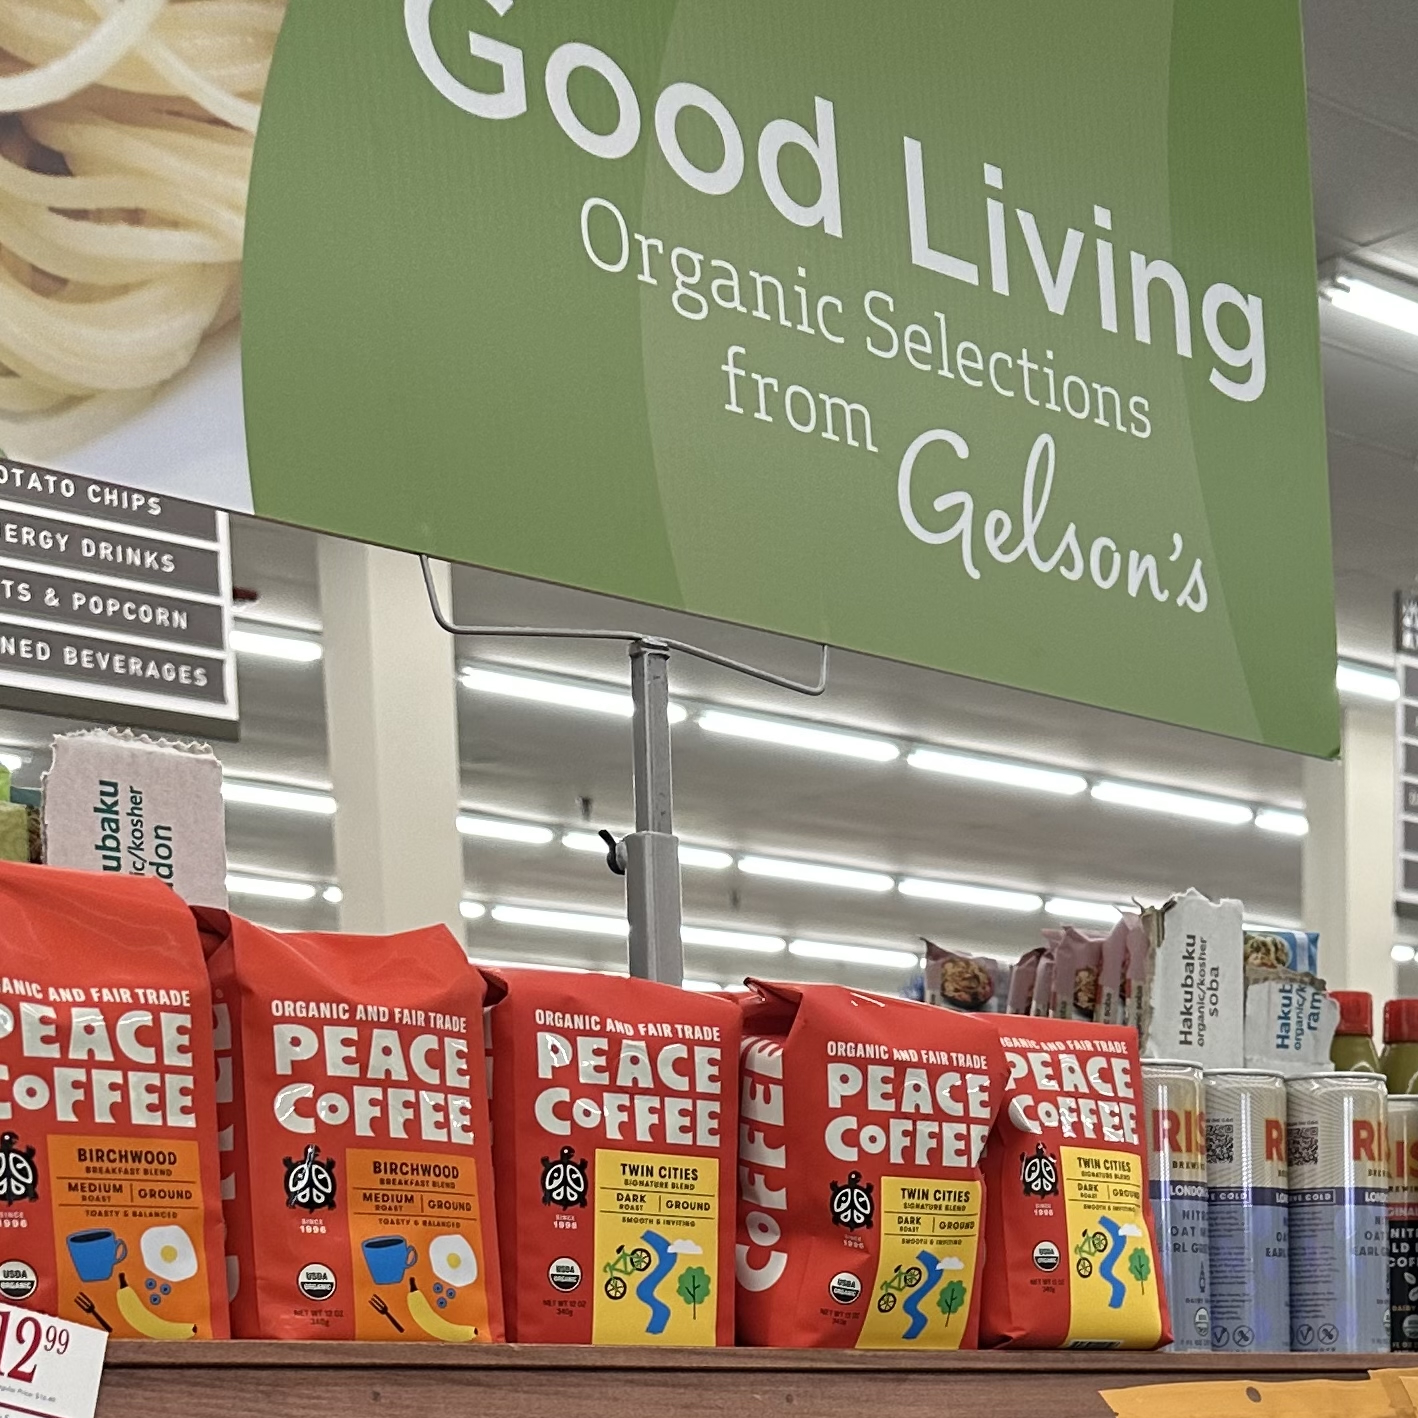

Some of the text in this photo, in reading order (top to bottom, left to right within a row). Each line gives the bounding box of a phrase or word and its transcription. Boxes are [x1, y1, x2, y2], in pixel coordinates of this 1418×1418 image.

[404, 0, 1266, 402] Good Living
[581, 198, 1151, 439] Organic Selections
[721, 345, 878, 452] from
[87, 484, 162, 516] CHIPS
[898, 429, 1208, 612] Gelson's
[82, 538, 175, 572] DRINKS
[44, 588, 60, 607] &
[72, 592, 187, 630] POPCORN
[63, 645, 208, 686] BEVERAGES
[0, 977, 190, 1007] ANIC AND FAIR TRADE
[1179, 934, 1196, 1046] Hakubaku
[1207, 966, 1220, 1017] soba
[271, 1000, 467, 1034] ORGANIC AND FAIR TRADE
[535, 1009, 720, 1042] ORGANIC AND FAIR TRADE
[273, 1023, 470, 1089] PEACE
[536, 1032, 722, 1095] PEACE
[827, 1041, 987, 1070] ORGANIC AND FAIR TRADE
[827, 1063, 990, 1118] PEACE
[1006, 1053, 1135, 1099] PEACE
[273, 1082, 475, 1145] COFFEE
[534, 1087, 720, 1147] COFFEE
[1009, 1094, 1139, 1145] COFFEE
[78, 1147, 177, 1166] BIRCHWOOD
[824, 1116, 989, 1168] COFFEE
[85, 1165, 172, 1177] BREAKFAST BLEND
[372, 1160, 459, 1180] BIRCHWOOD
[620, 1163, 698, 1181] TWIN CITIES
[68, 1181, 123, 1195] MEDIUM
[138, 1188, 192, 1201] GROUND
[362, 1192, 414, 1205] MEDIUM
[616, 1192, 646, 1203] DARK
[901, 1187, 970, 1203] TWIN CITIES
[428, 1199, 472, 1212] GROUND
[666, 1200, 710, 1211] GROUND
